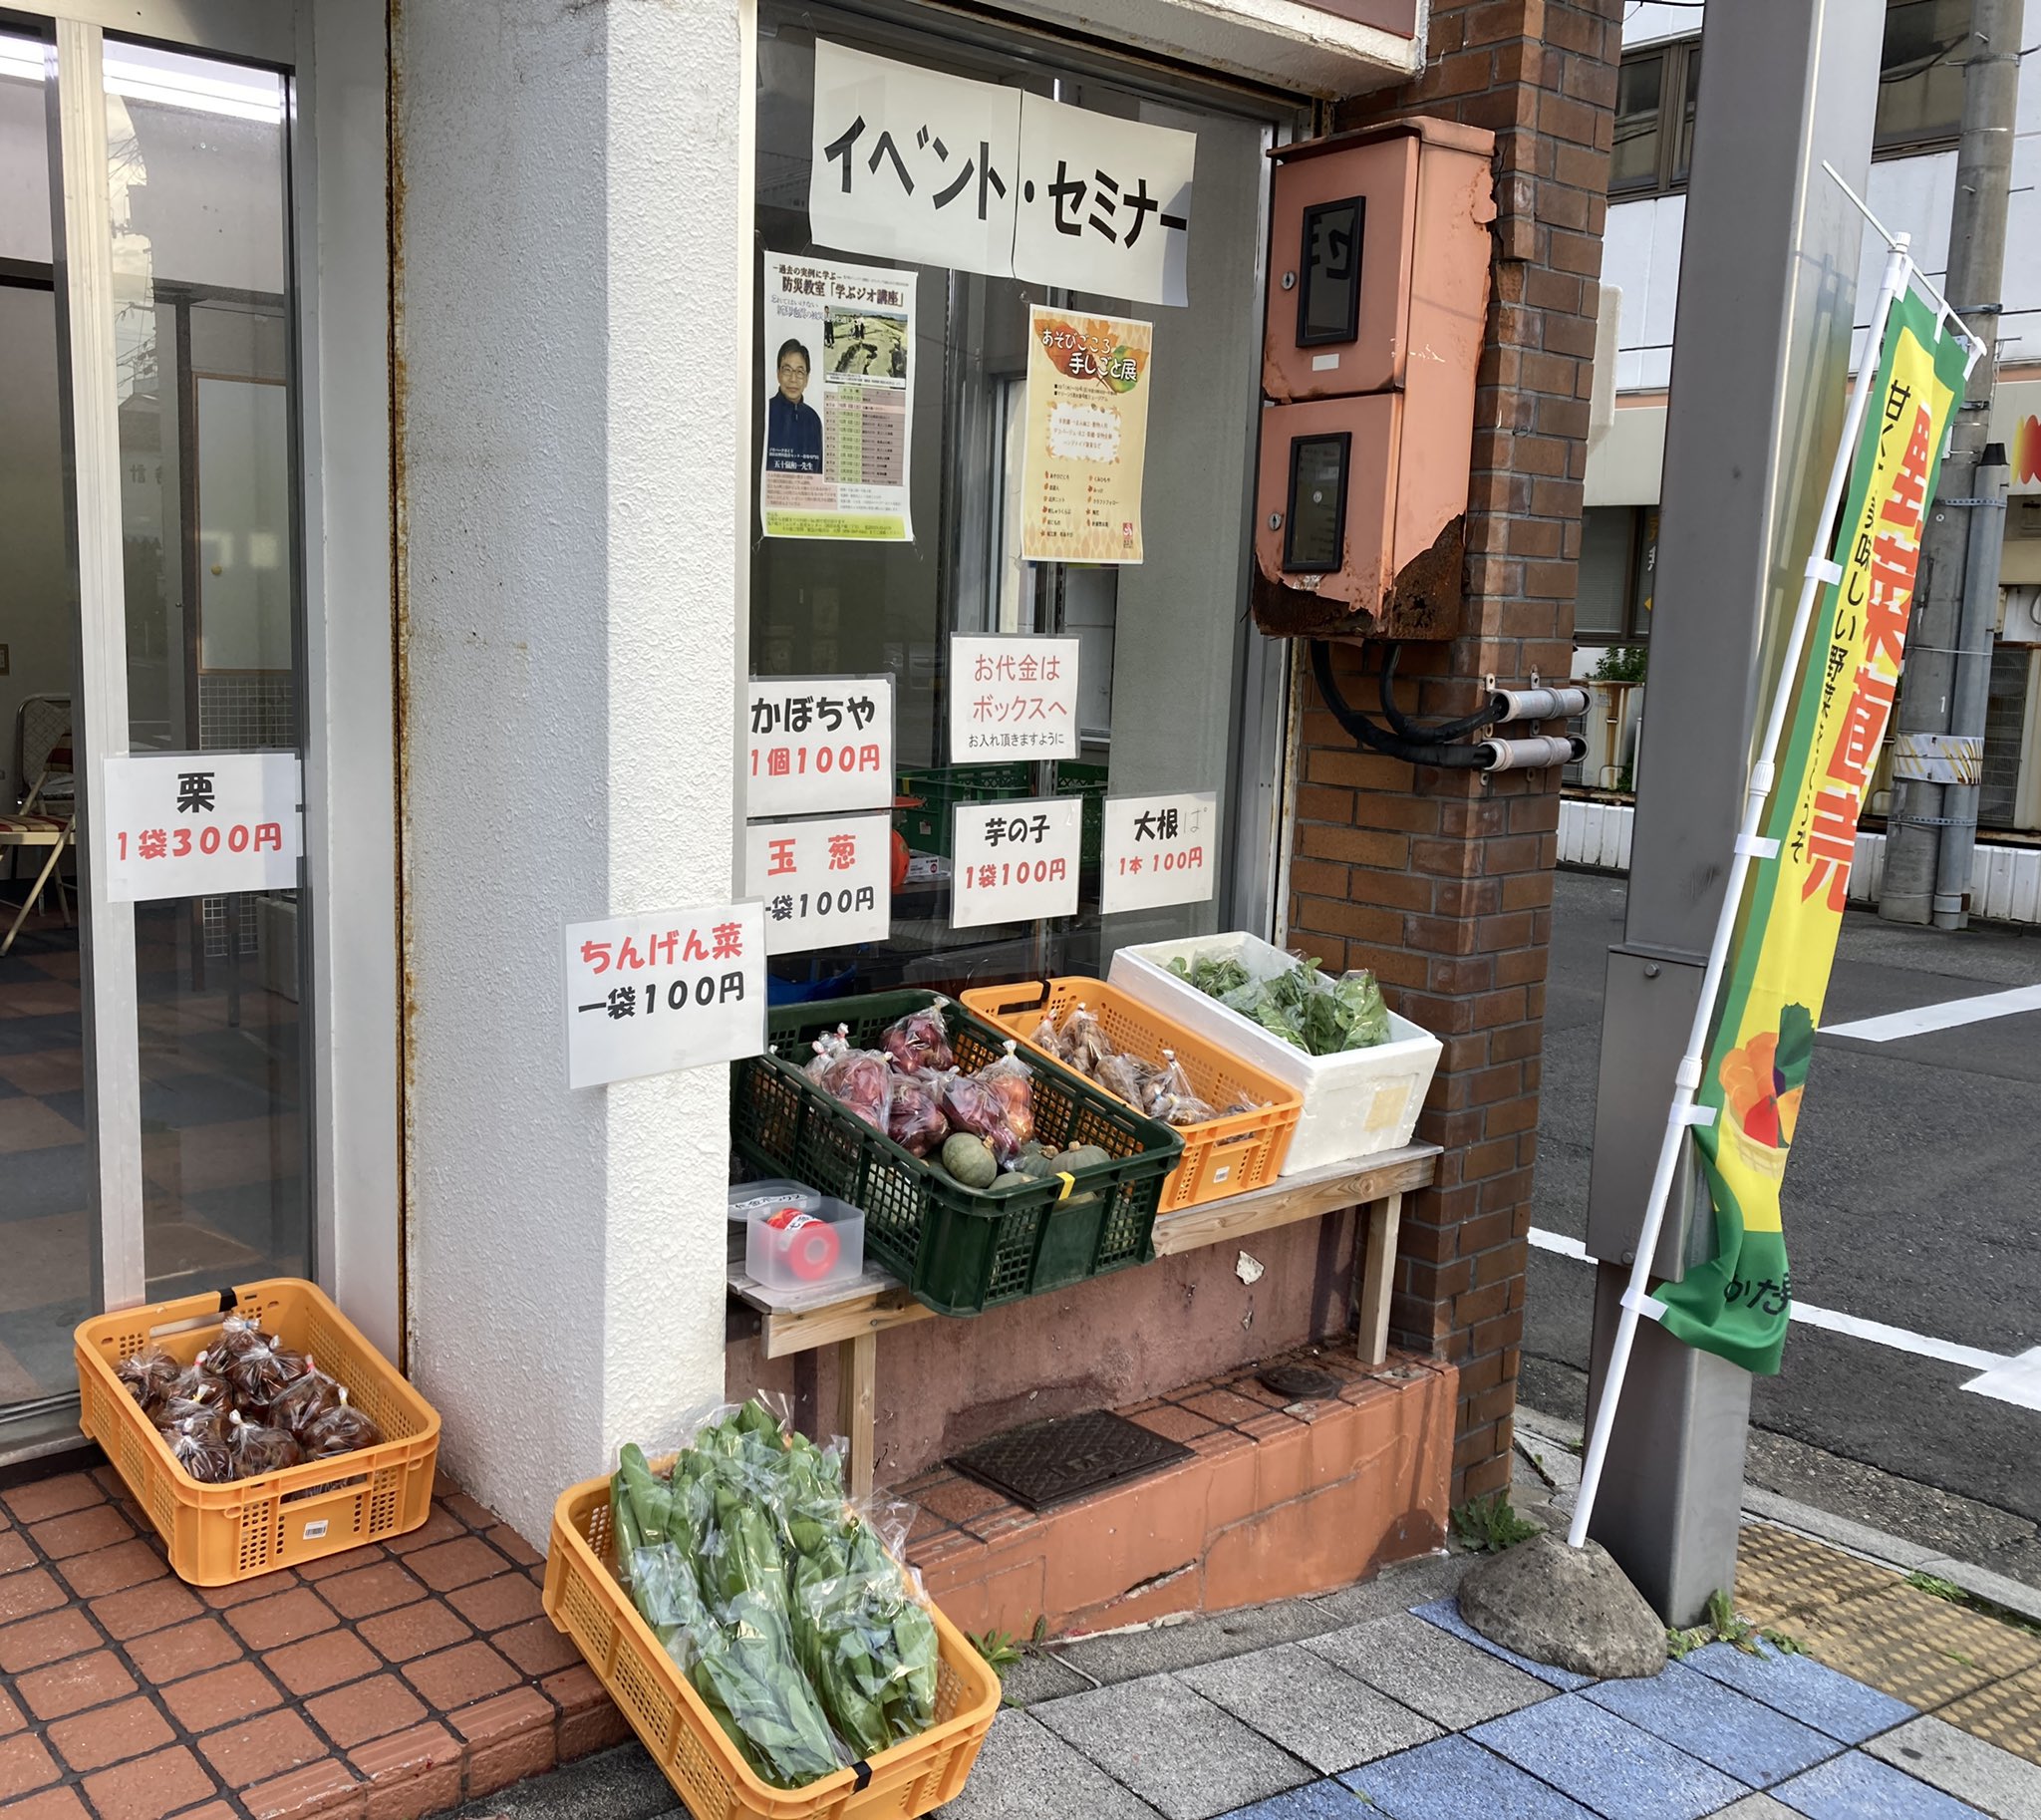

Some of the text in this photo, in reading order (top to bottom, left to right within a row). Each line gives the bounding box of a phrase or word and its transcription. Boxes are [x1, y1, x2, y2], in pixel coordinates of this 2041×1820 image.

[824, 115, 1188, 249] イベント・セミナー
[782, 276, 904, 307] 防災教室「学ぶジオ講座」
[1042, 328, 1111, 355] あそびごころ
[1068, 352, 1138, 383] 手しごと展
[975, 653, 1060, 683] お代金は
[973, 695, 1068, 724] ボックスへ
[968, 732, 1064, 749] お入れ頂きますように
[750, 744, 881, 776] 1個100円
[176, 771, 215, 813] 栗
[118, 822, 282, 861] 1袋300円
[985, 814, 1050, 847] 芋の子
[966, 857, 1067, 889] 1袋100円
[580, 922, 743, 975] ちんげん菜
[578, 971, 744, 1020] 一袋100円
